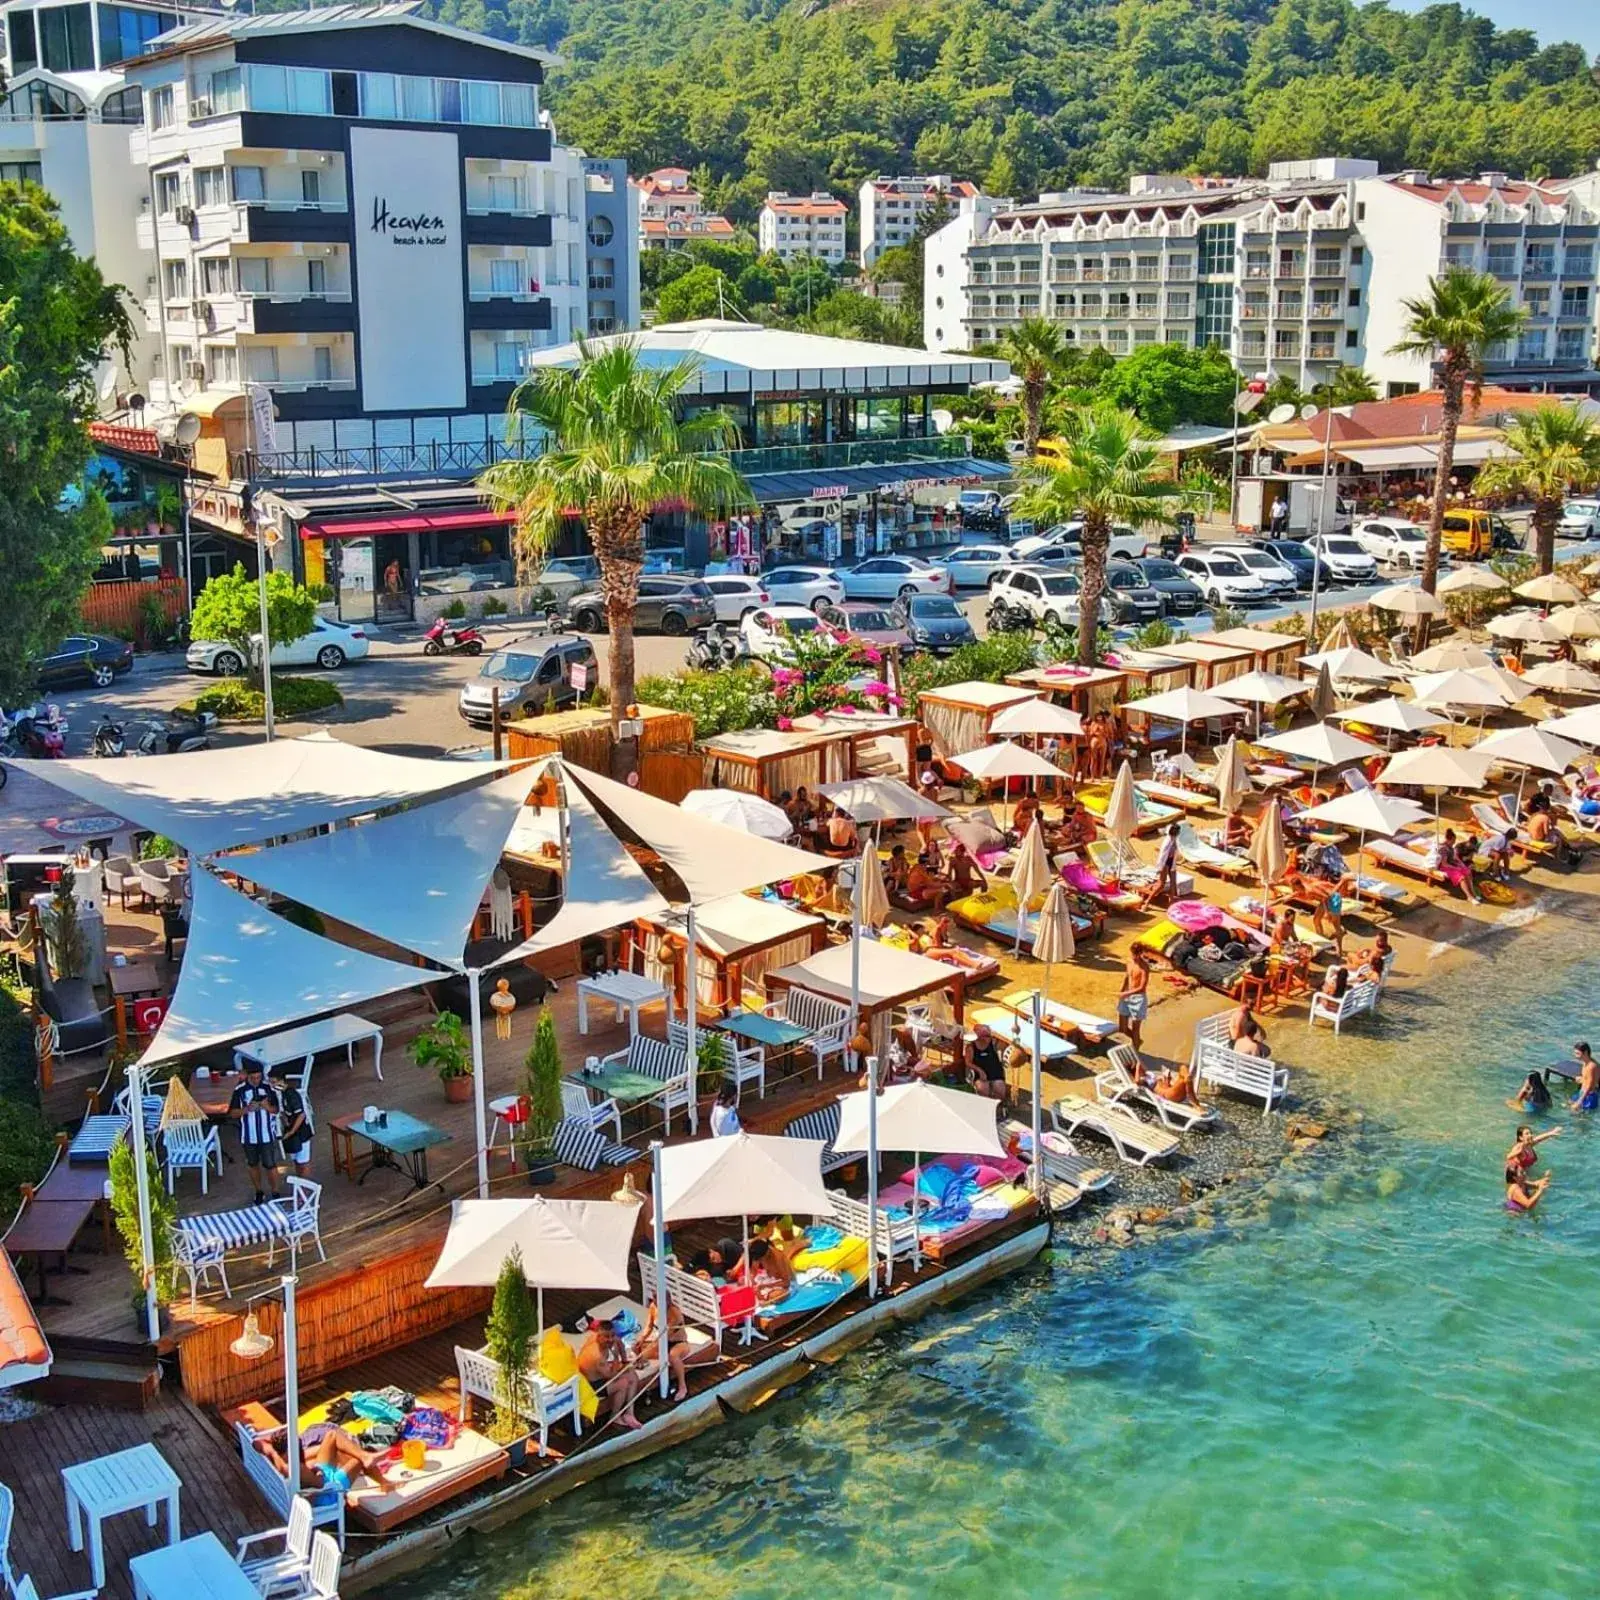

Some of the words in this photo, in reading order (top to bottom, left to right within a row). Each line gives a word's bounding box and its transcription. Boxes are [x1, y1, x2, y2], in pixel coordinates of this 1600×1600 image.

[371, 196, 444, 234] Heaven
[393, 235, 416, 245] beach
[426, 235, 447, 245] hotel
